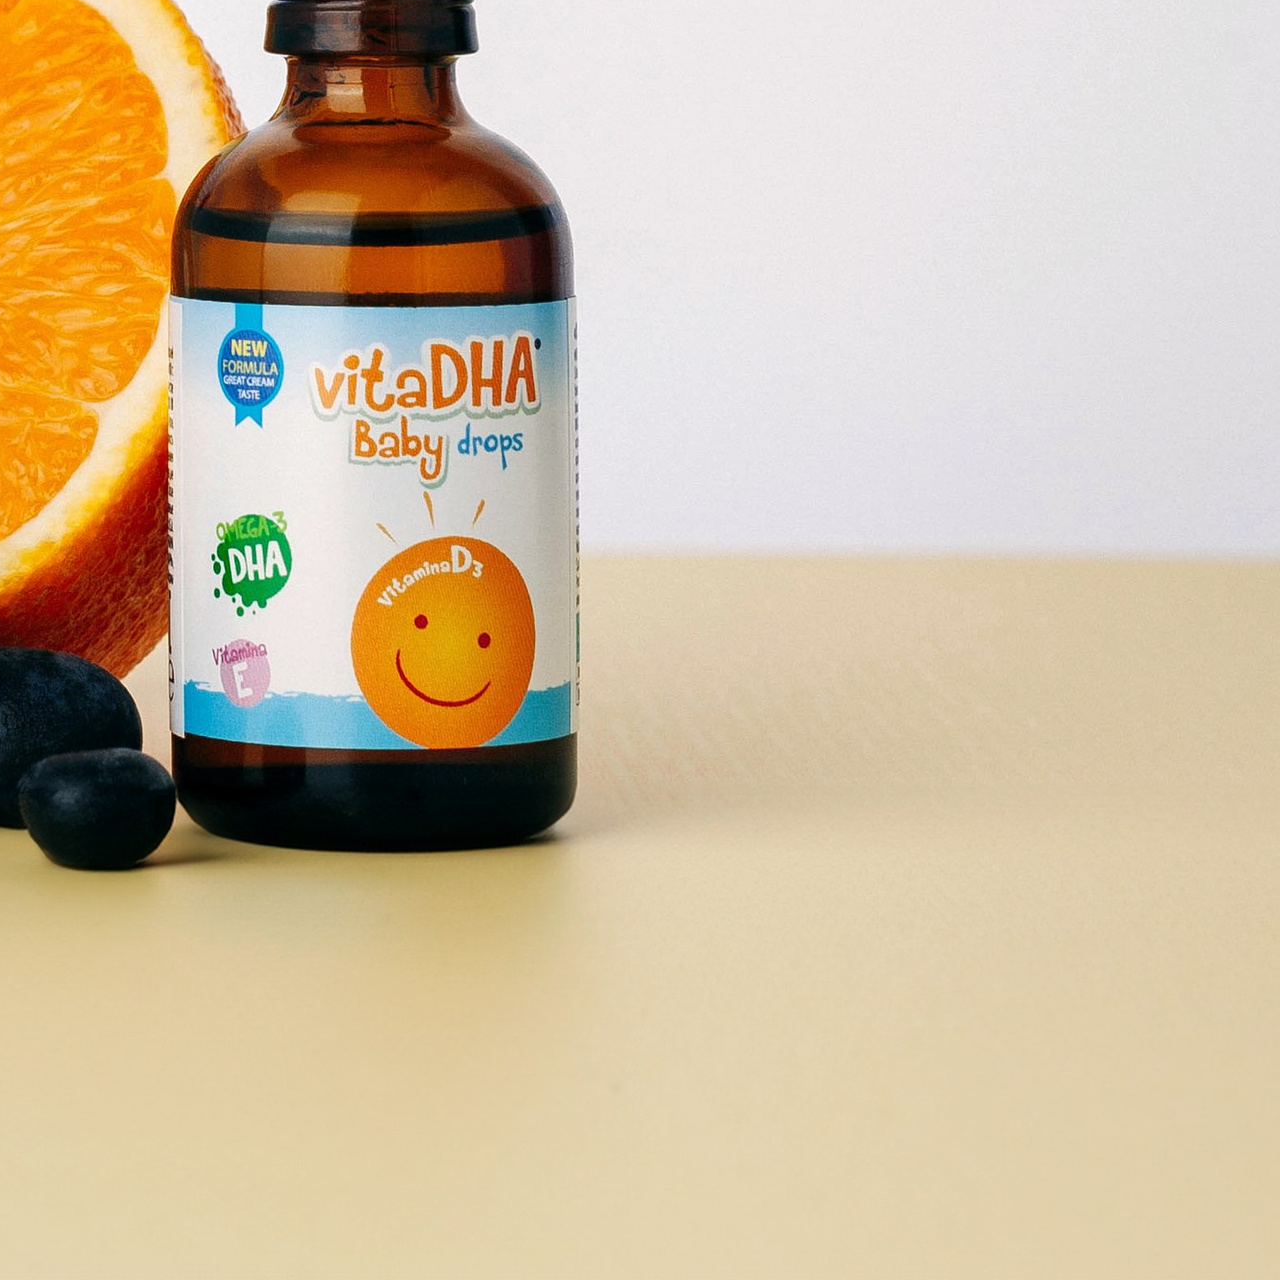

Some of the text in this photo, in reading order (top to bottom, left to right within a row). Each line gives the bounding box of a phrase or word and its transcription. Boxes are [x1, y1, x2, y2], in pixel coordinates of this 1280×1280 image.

[231, 339, 267, 357] NEW
[222, 359, 278, 376] FORMULA
[223, 374, 275, 387] GREAT CREAM
[315, 336, 536, 411] vitaDHA
[237, 389, 261, 400] TASTE
[355, 416, 523, 480] Baby drops
[216, 511, 287, 542] OMEGA-3
[228, 540, 288, 584] DHA
[212, 642, 267, 666] Vitamina
[233, 661, 253, 699] E
